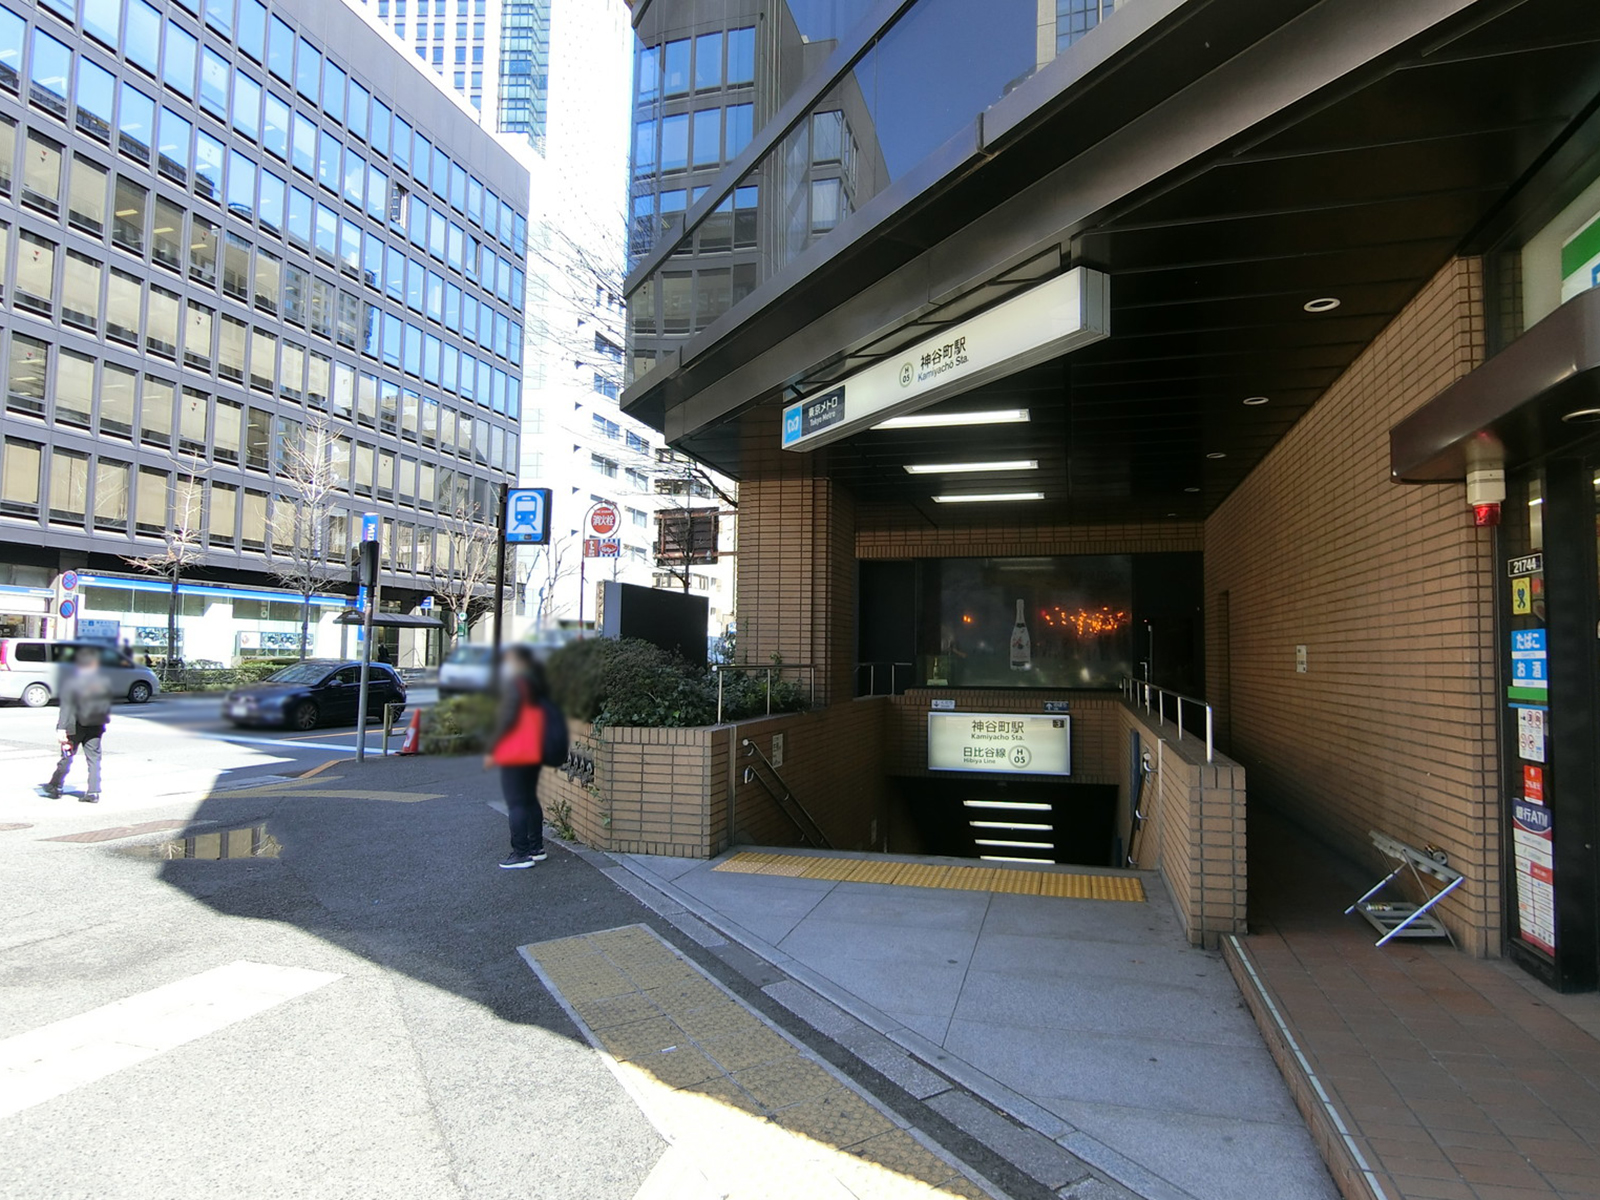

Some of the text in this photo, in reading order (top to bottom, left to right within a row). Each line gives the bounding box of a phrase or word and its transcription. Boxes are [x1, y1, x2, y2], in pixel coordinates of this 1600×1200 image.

[920, 336, 967, 371] 神谷町駅
[956, 355, 969, 366] Sta.
[902, 374, 910, 383] 05
[808, 396, 838, 418] 東京メトロ
[810, 411, 836, 426] Tokyo Metro
[593, 515, 614, 526] 消火栓
[1513, 557, 1537, 574] 21744
[1516, 632, 1541, 650] たばこ
[971, 719, 1025, 734] 神谷町駅
[963, 746, 1006, 758] 日比谷線
[1016, 748, 1023, 756] H
[1013, 756, 1026, 764] 05
